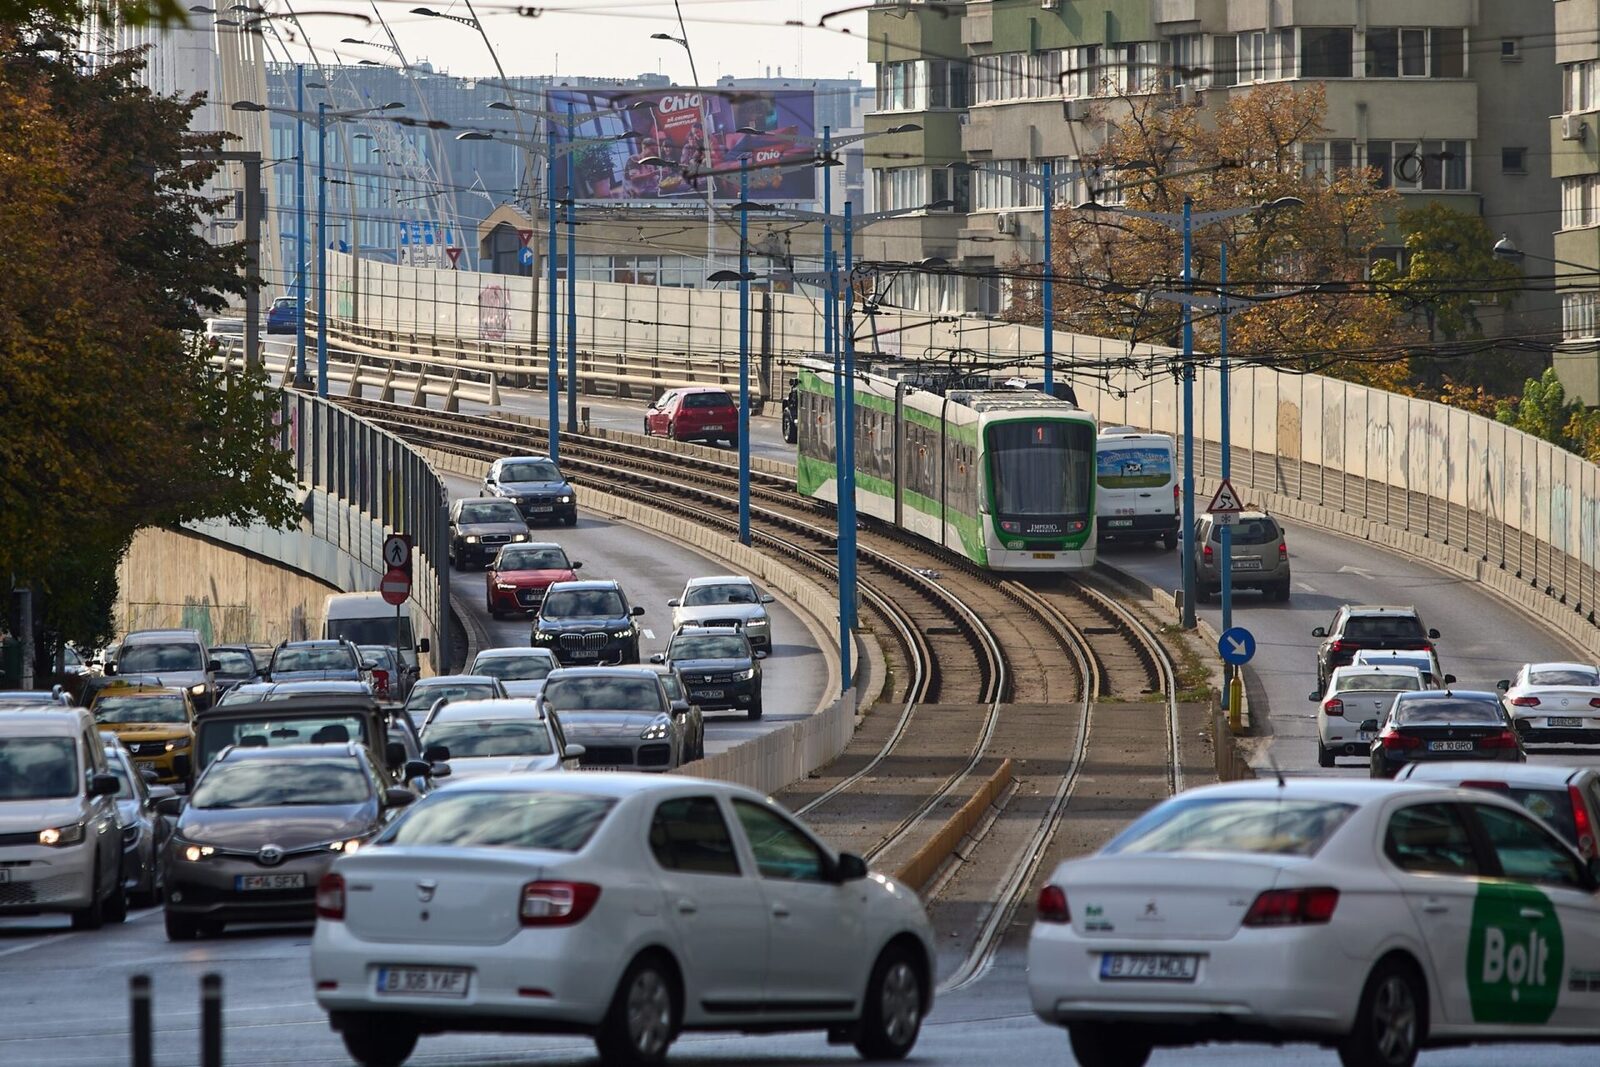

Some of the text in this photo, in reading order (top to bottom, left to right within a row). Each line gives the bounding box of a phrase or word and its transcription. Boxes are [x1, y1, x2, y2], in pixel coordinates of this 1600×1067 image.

[659, 93, 701, 114] Chio
[756, 149, 780, 161] Chio
[1036, 427, 1042, 440] 1
[1432, 742, 1472, 750] GR 10 GRO
[1111, 957, 1123, 974] B
[1129, 957, 1156, 975] 779
[1482, 926, 1548, 1001] Bolt
[388, 971, 399, 989] B
[432, 973, 461, 990] YAF
